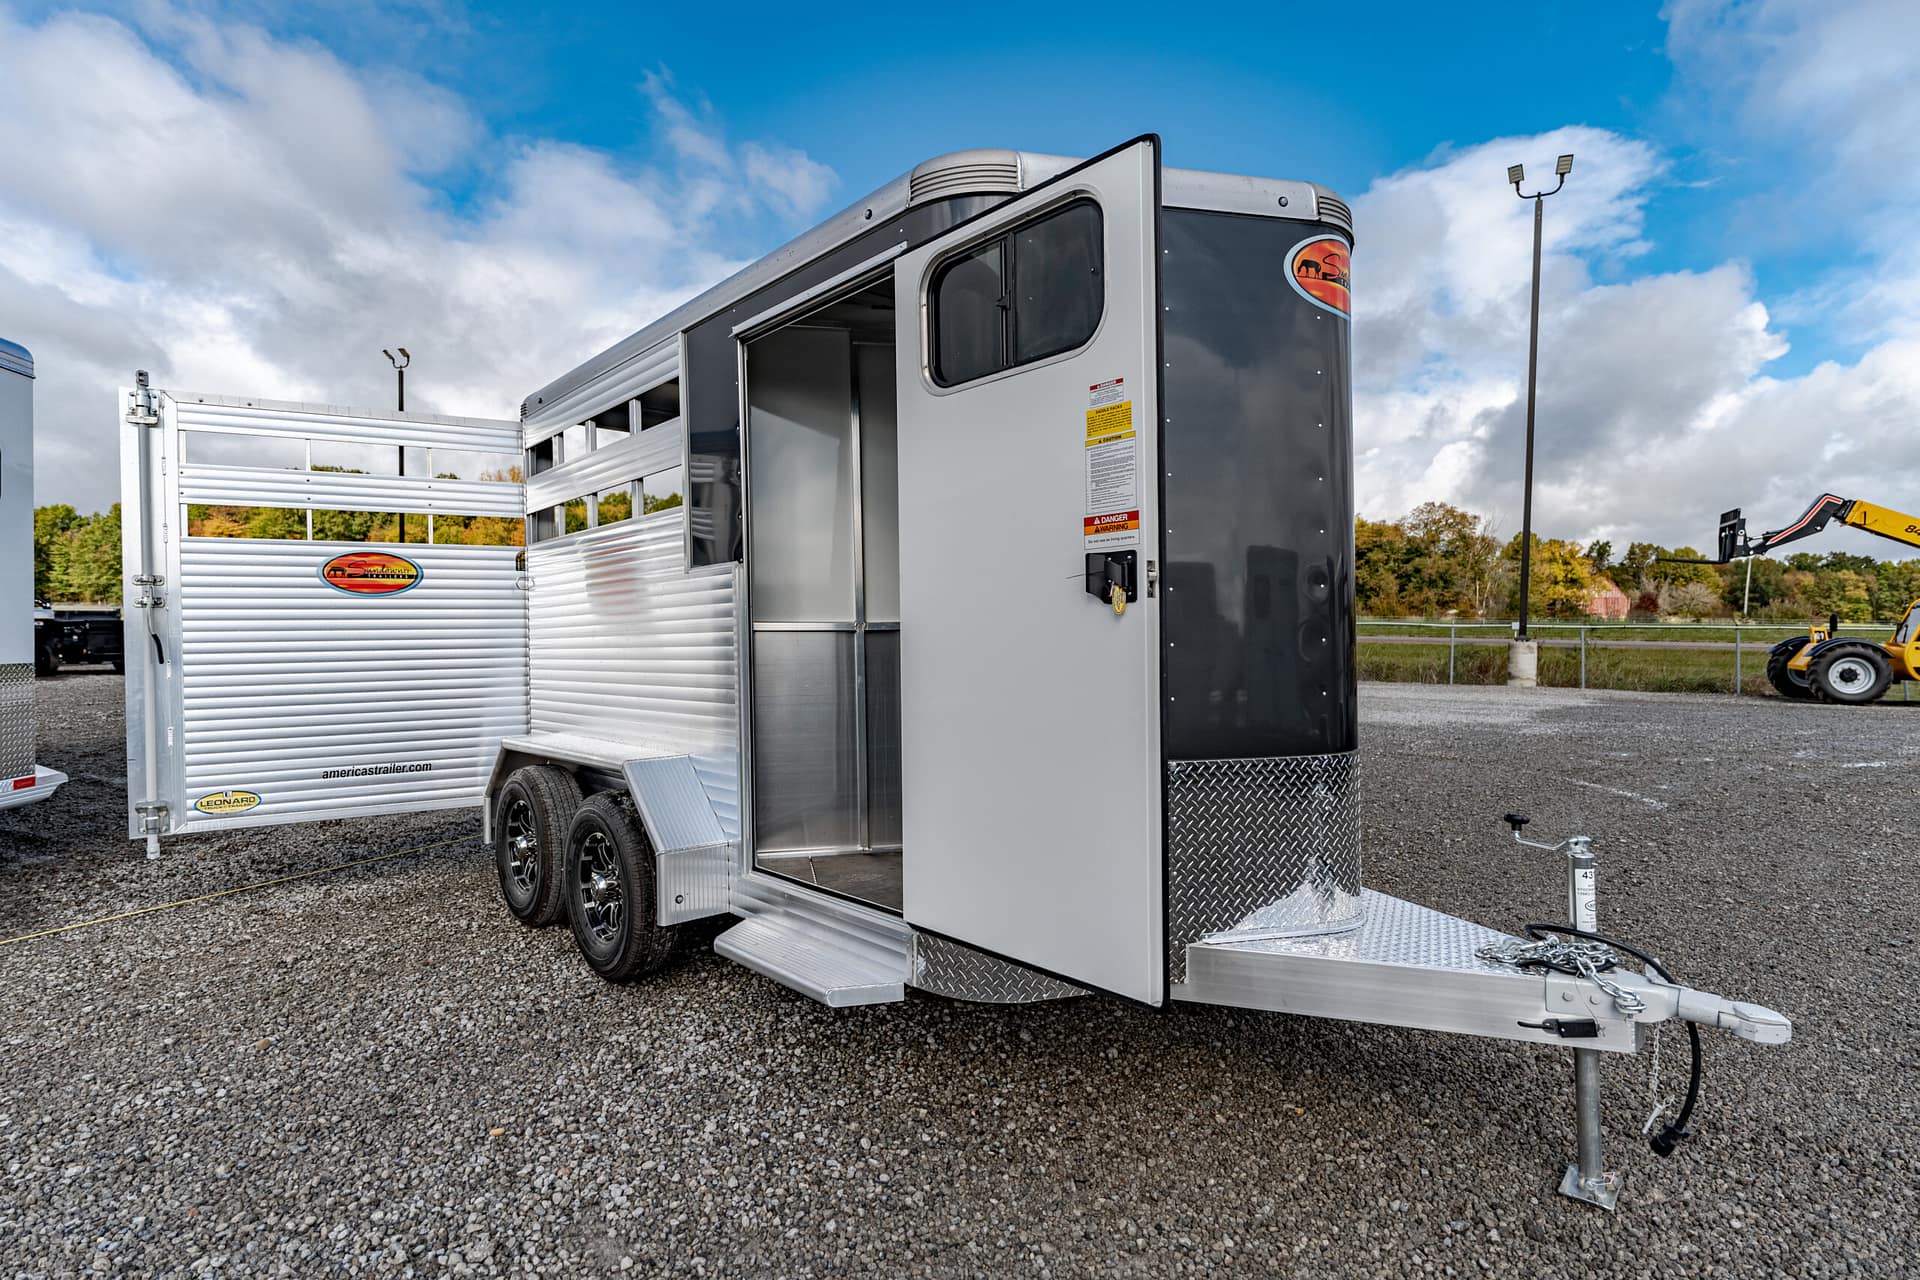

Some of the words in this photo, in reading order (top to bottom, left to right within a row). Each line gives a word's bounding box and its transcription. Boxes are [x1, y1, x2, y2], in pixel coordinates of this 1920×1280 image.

[1103, 434, 1122, 443] CAUTION
[1102, 514, 1128, 523] DANGER
[1100, 522, 1129, 534] WARNING
[322, 763, 432, 779] americastrailer.com
[200, 796, 256, 808] LEONARD
